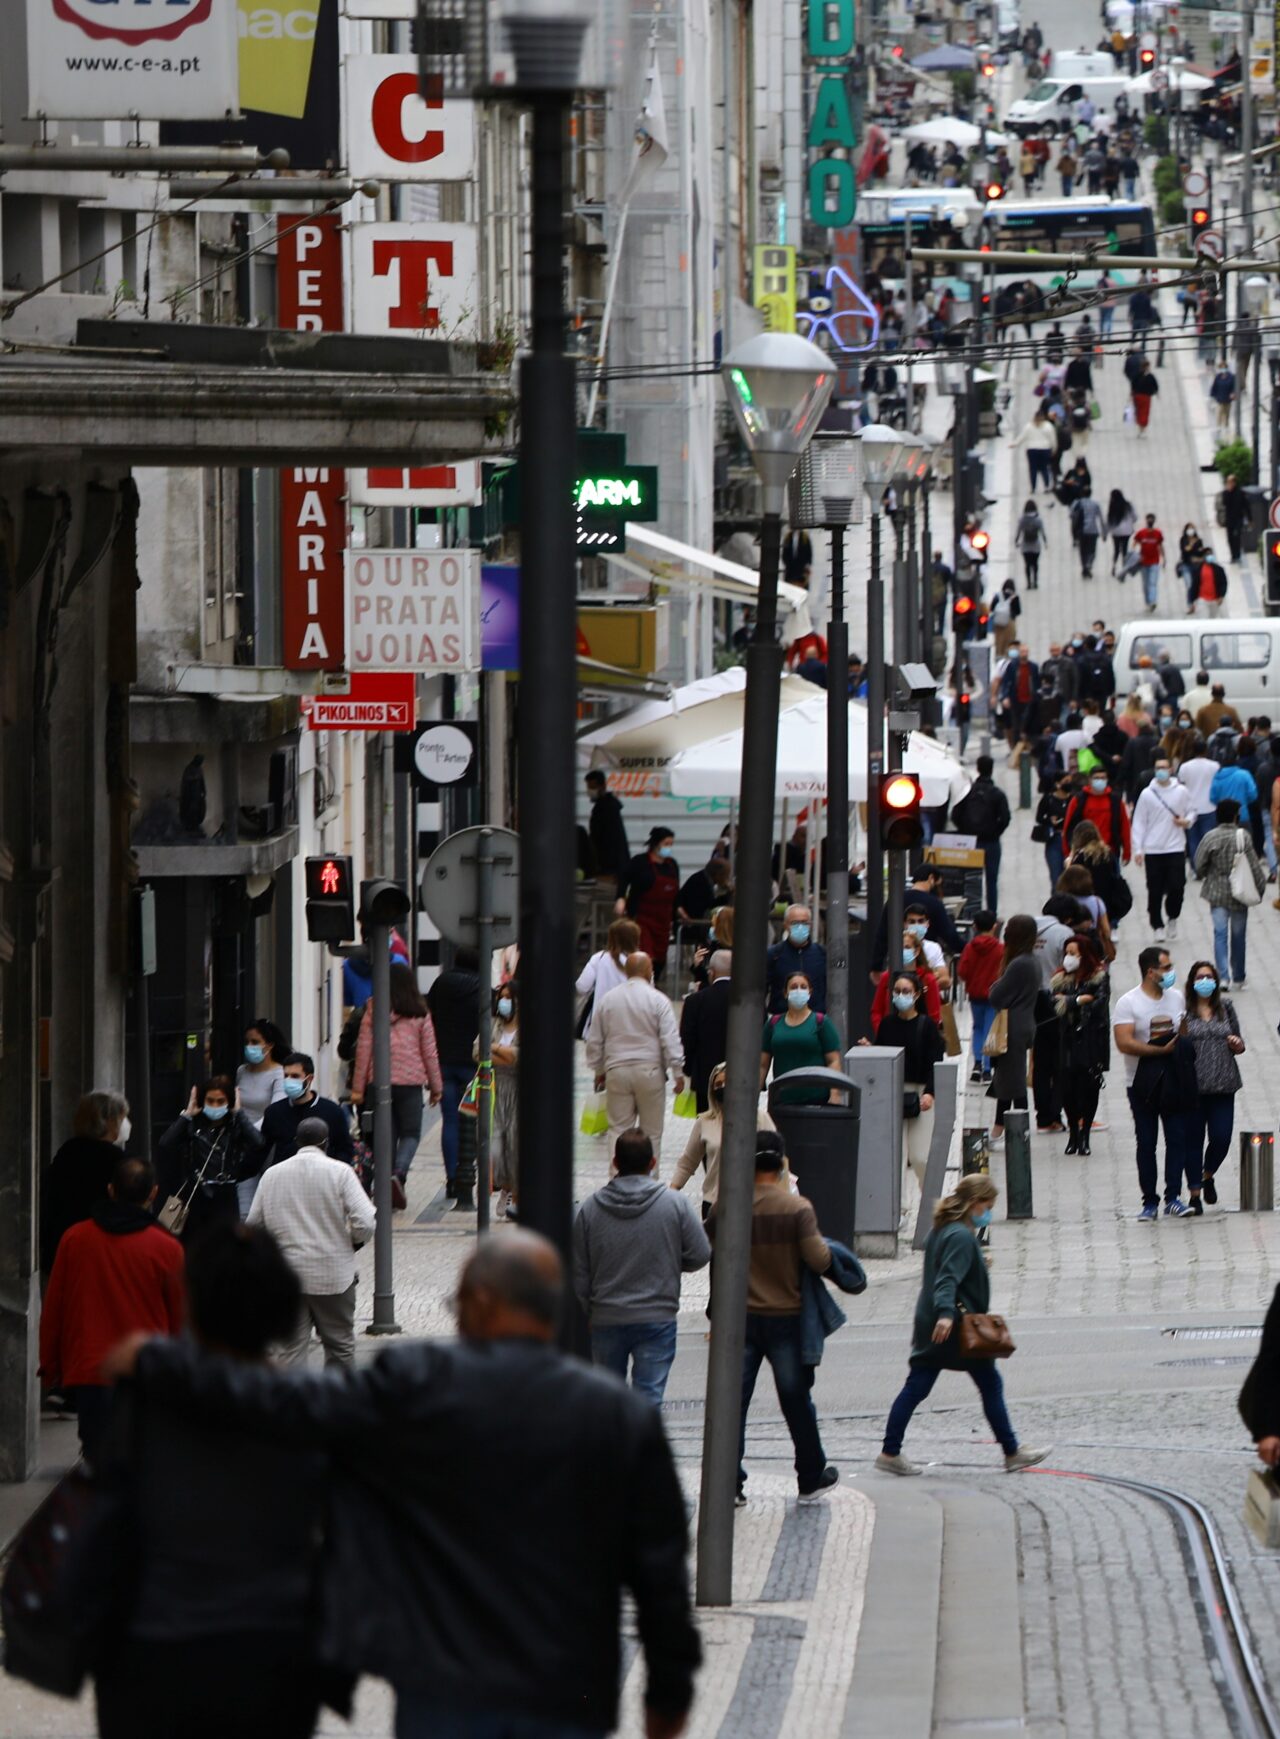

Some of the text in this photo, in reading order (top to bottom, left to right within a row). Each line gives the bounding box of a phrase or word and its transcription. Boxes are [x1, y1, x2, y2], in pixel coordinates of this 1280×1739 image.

[238, 8, 317, 40] ac
[66, 56, 201, 75] www.c-e-a.pt
[354, 557, 460, 586] OURO
[354, 595, 460, 625] PRATA
[355, 633, 461, 663] JOIAS
[318, 705, 384, 721] PIKOLINOS
[620, 757, 655, 768] SUPER
